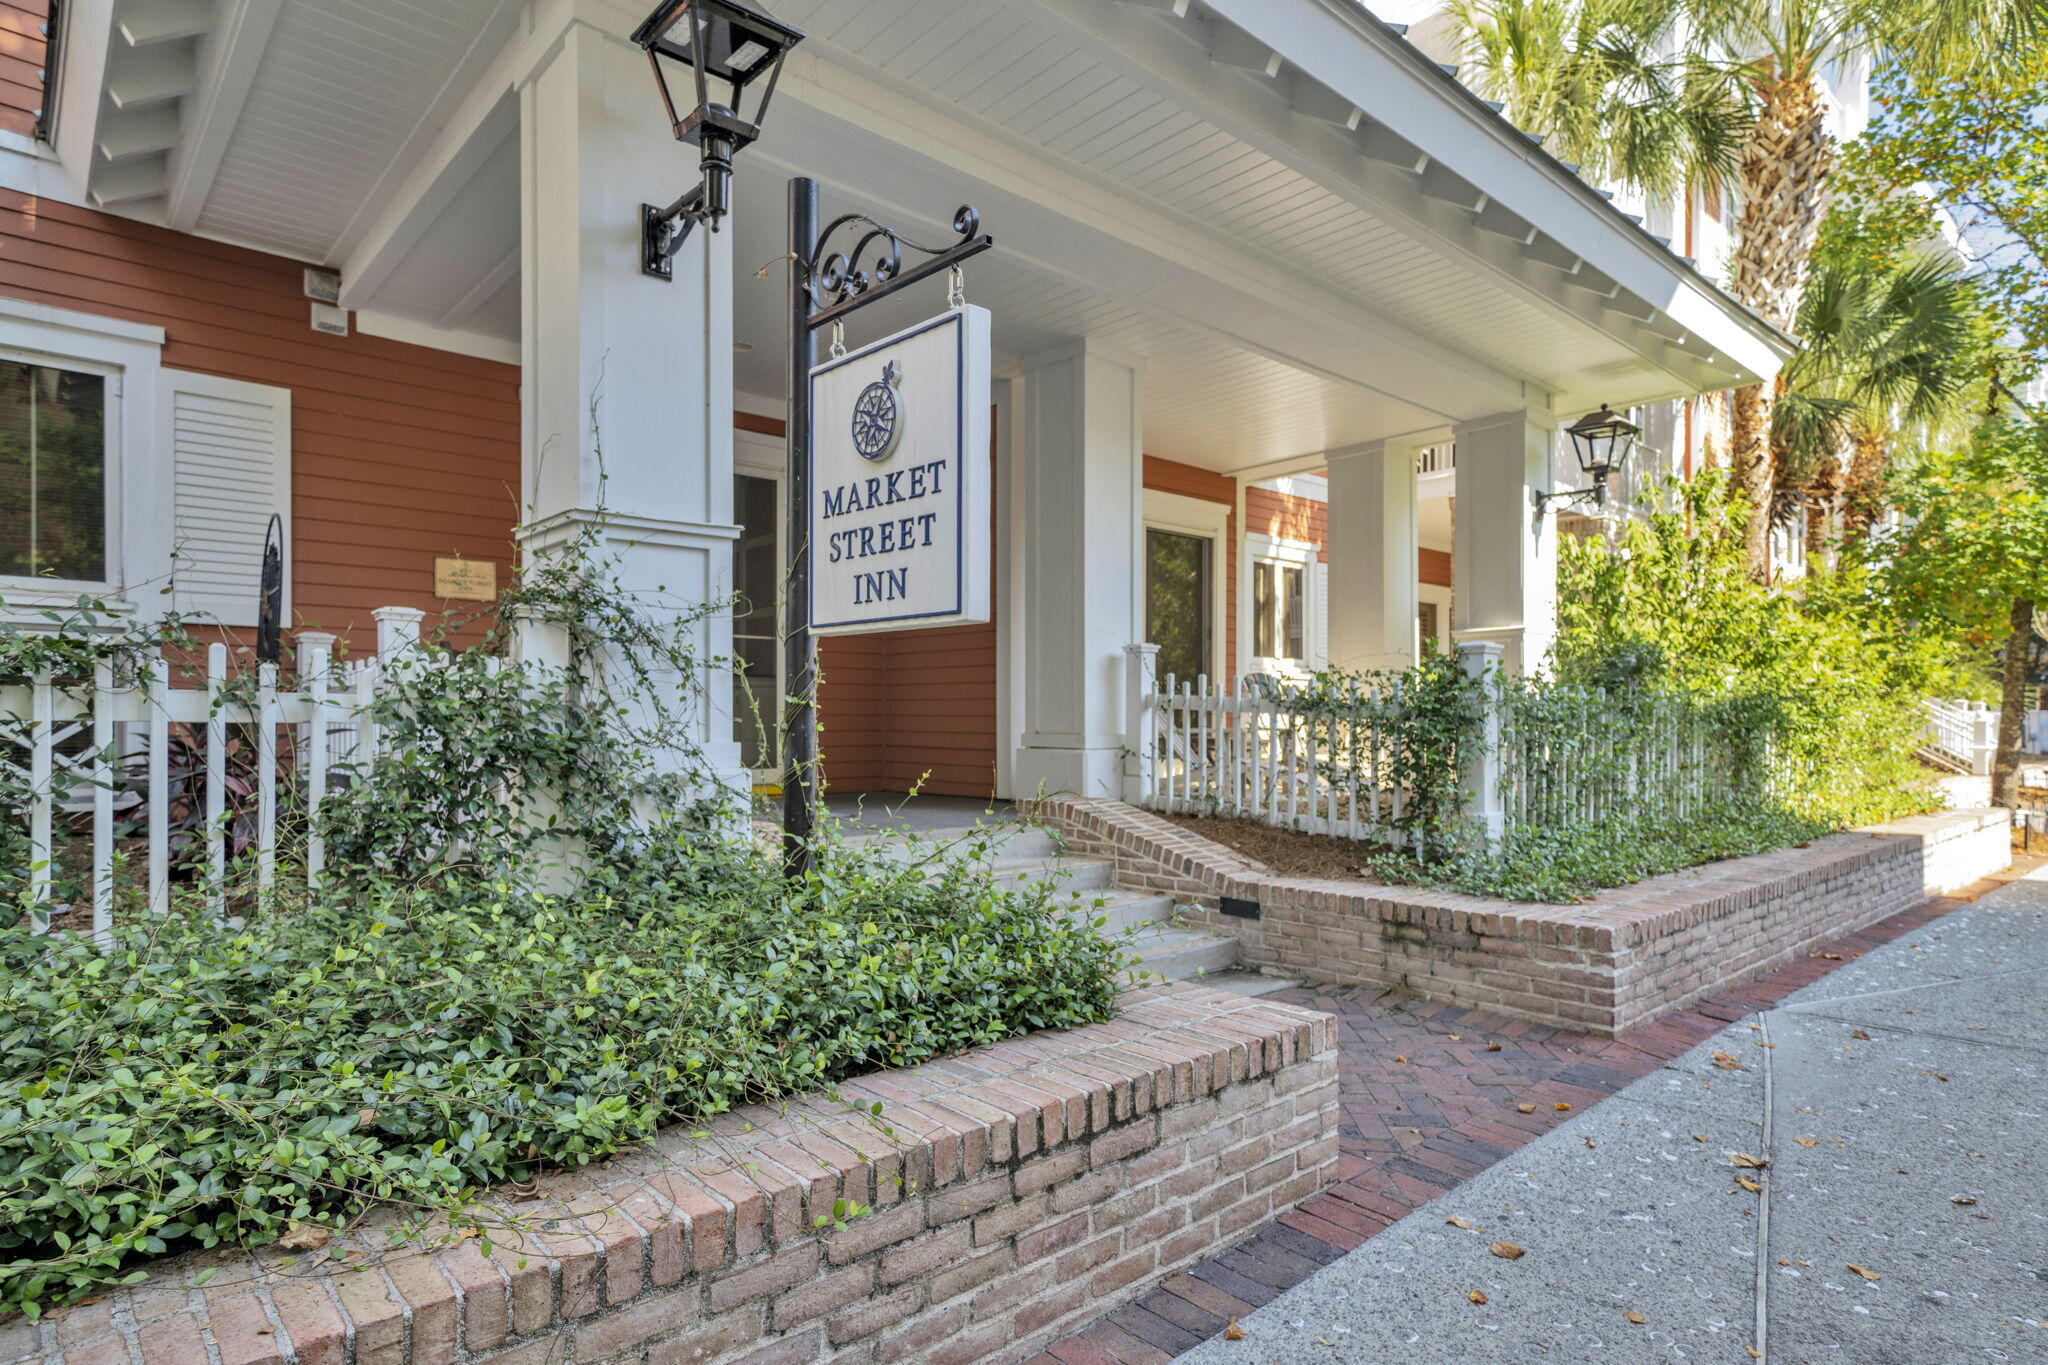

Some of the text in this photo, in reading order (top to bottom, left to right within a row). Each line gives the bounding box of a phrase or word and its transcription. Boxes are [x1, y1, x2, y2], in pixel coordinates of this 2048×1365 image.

[822, 459, 947, 519] MARKET
[829, 512, 937, 563] STREET
[853, 567, 909, 605] INN
